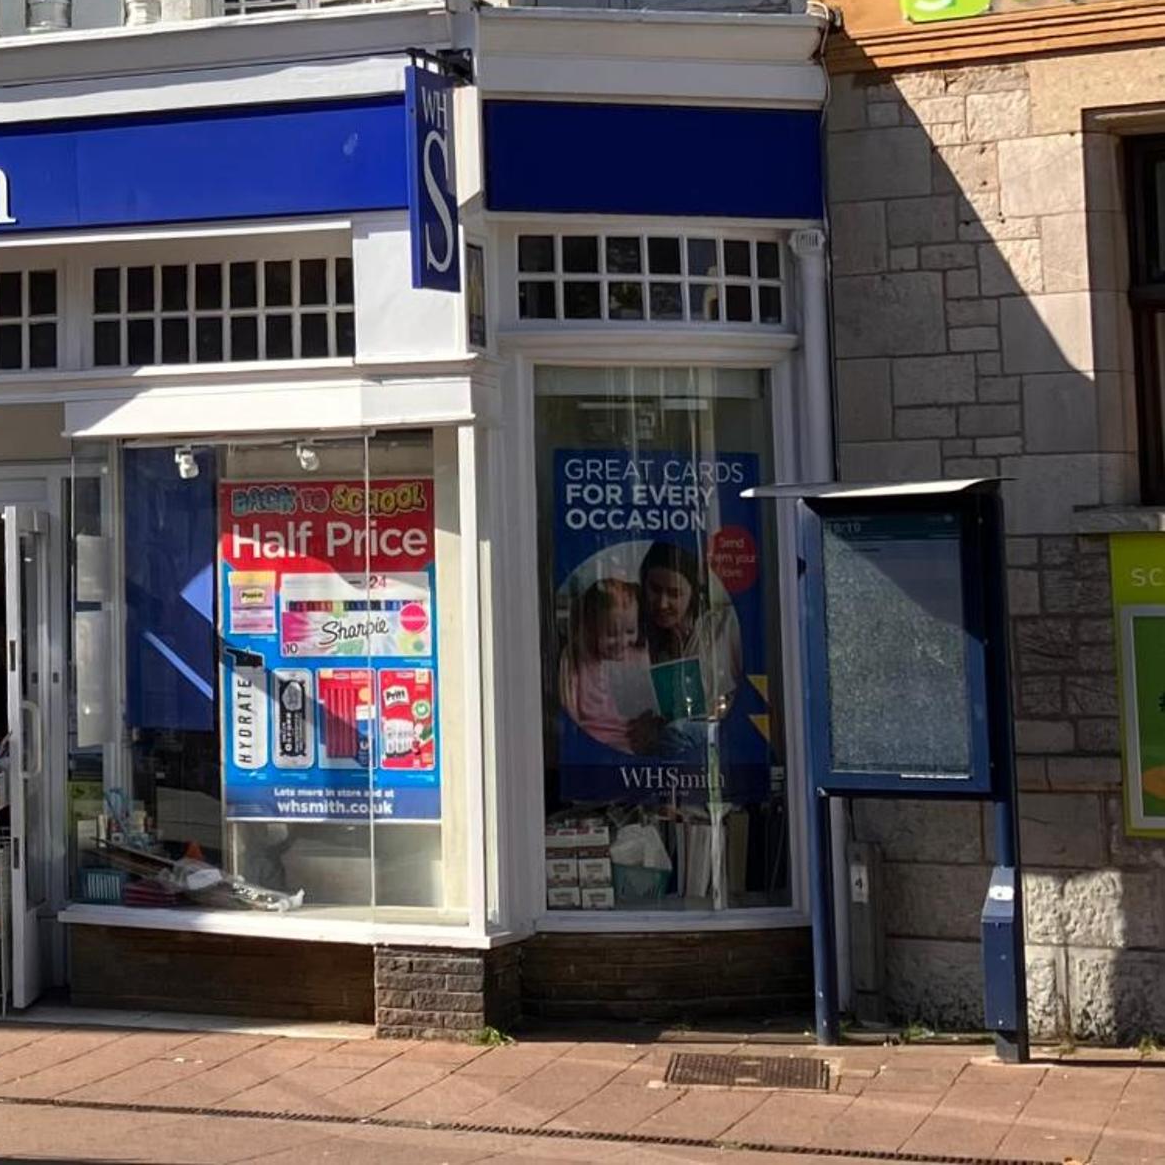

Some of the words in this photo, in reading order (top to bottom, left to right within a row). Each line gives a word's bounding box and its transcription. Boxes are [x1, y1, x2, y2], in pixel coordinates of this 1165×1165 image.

[421, 85, 449, 130] WH
[423, 130, 455, 273] S
[564, 459, 654, 481] GREAT
[664, 460, 744, 483] CARDS
[333, 483, 426, 516] SCHOOL
[566, 484, 623, 505] FOR
[634, 485, 714, 507] EVERY
[565, 508, 706, 531] OCCASION
[232, 521, 313, 559] Half
[327, 519, 428, 557] Price
[319, 618, 389, 646] Sharpie
[237, 678, 253, 764] HYDRATE
[620, 766, 725, 788] WHSmih
